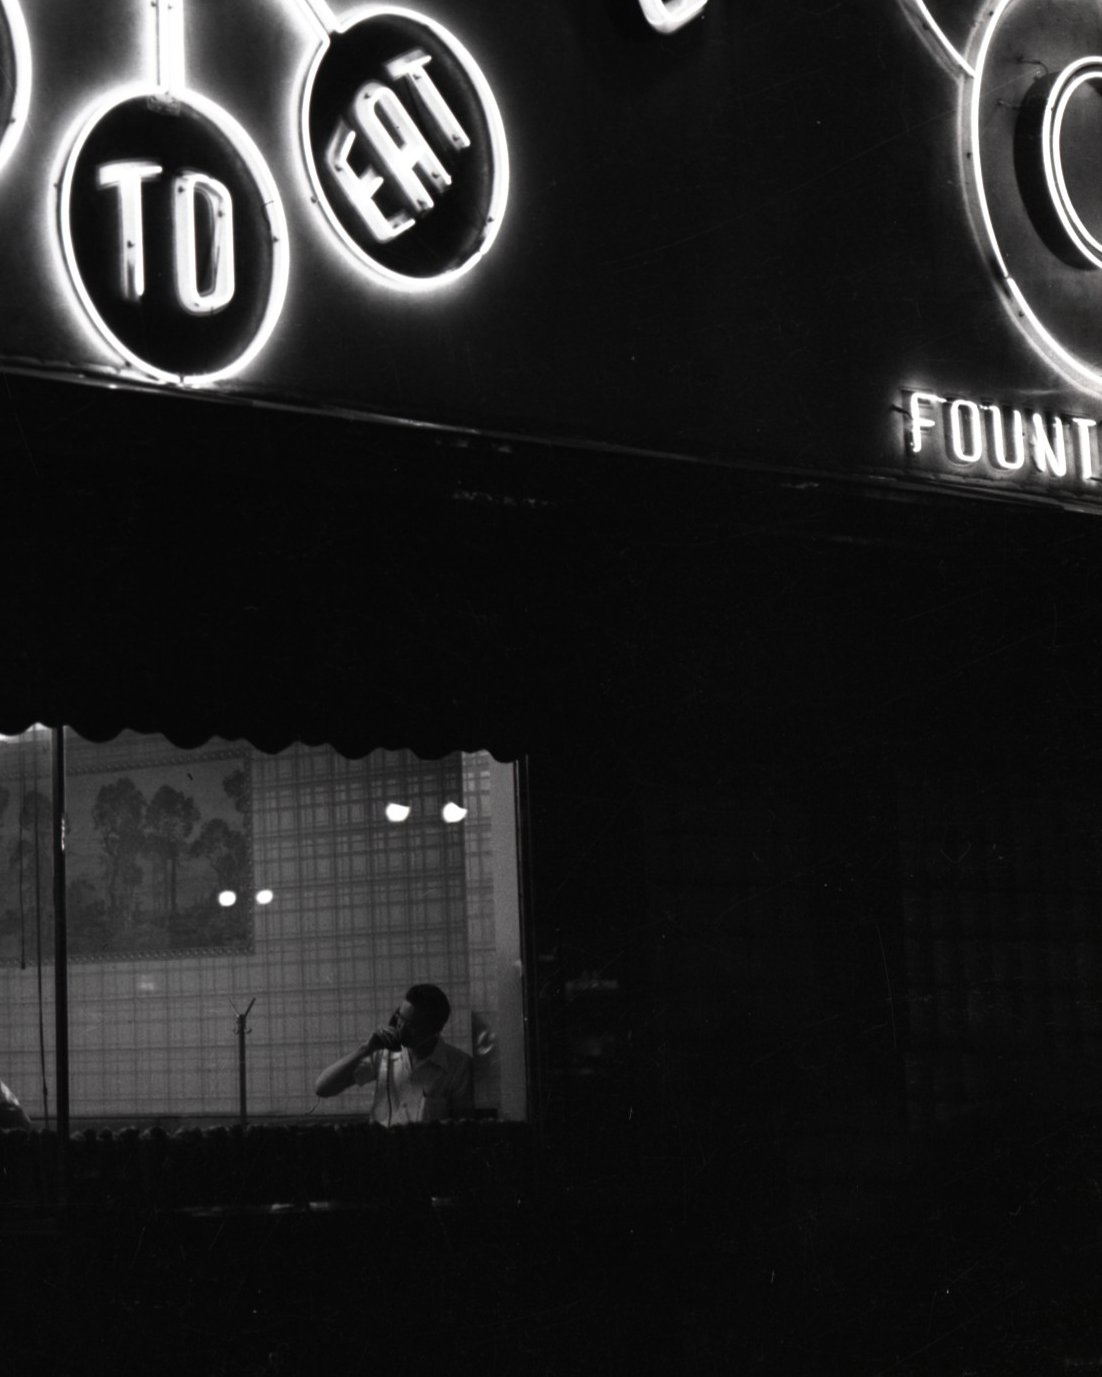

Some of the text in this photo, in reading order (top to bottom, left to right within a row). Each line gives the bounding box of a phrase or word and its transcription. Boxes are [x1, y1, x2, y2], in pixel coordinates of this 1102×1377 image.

[326, 48, 471, 243] EAT
[98, 160, 235, 316] TO
[910, 391, 1097, 480] FOUNT
